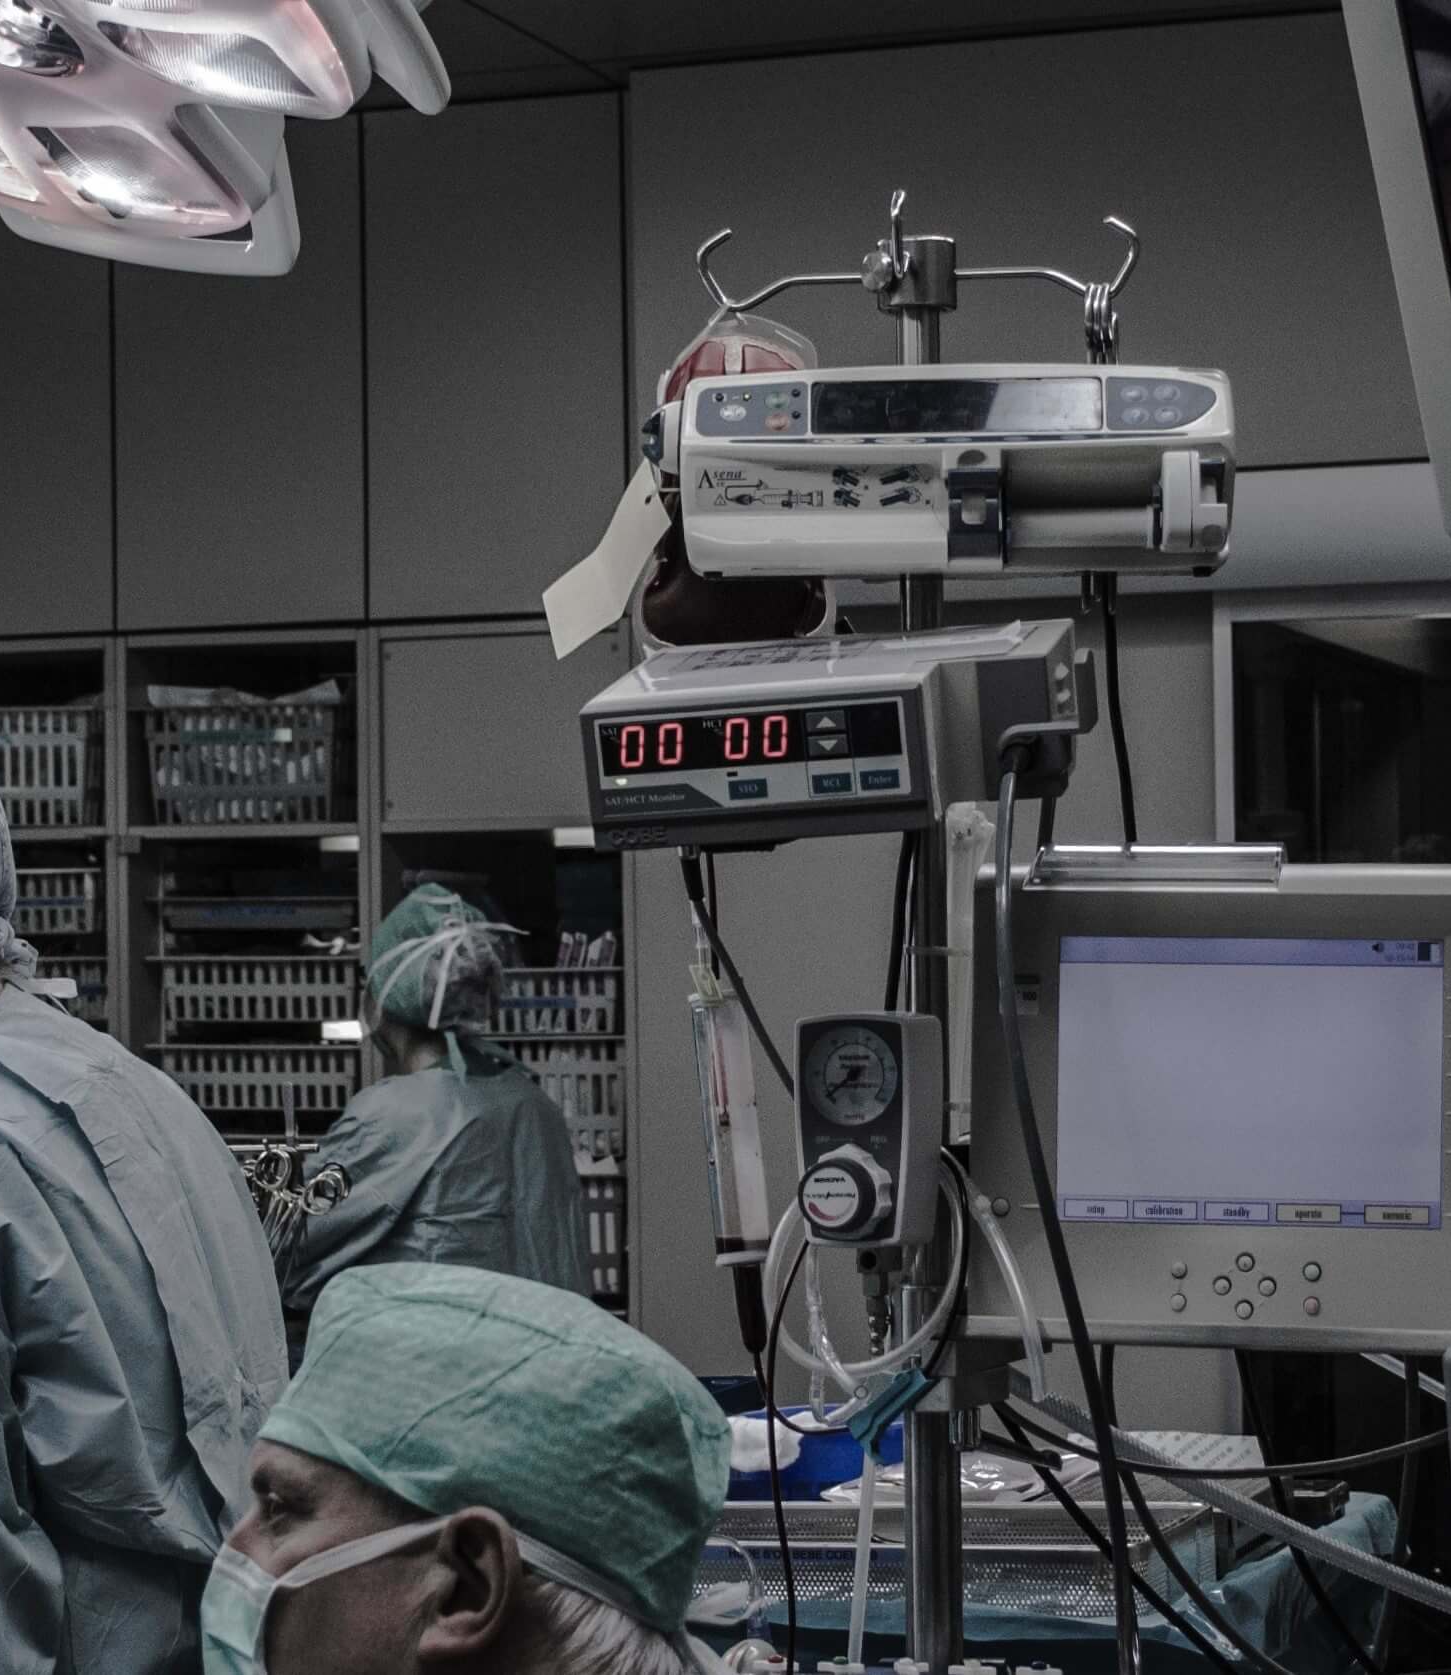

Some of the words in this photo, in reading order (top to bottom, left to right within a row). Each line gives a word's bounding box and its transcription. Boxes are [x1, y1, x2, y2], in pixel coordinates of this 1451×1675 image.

[868, 774, 893, 785] Enter
[647, 792, 686, 803] Monitor
[1223, 1206, 1250, 1218] standby
